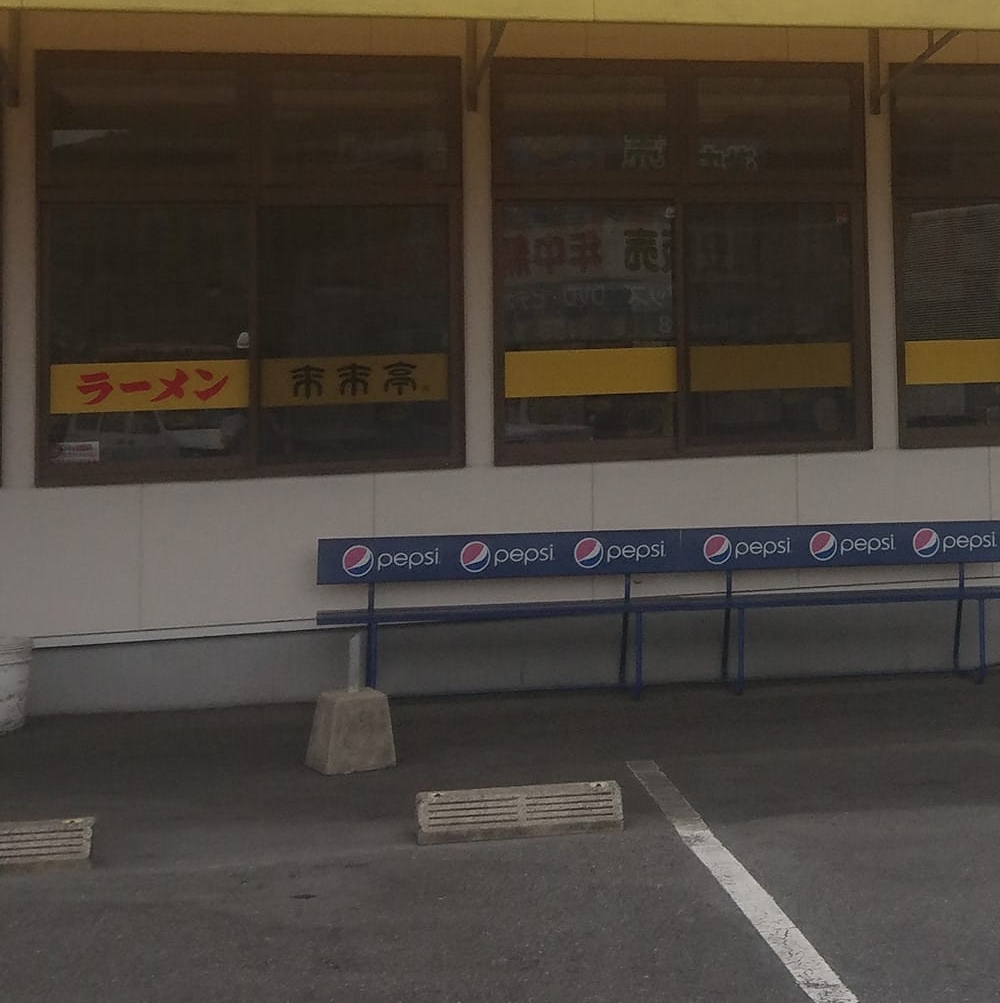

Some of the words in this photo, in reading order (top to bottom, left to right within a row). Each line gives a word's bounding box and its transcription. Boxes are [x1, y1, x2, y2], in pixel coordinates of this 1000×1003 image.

[76, 368, 229, 406] ラーメン
[607, 540, 666, 564] pepsi
[735, 537, 791, 559] pepsi
[840, 533, 896, 555] pepsi
[943, 531, 997, 553] pepsi
[377, 547, 440, 571] pepsi
[494, 544, 555, 568] pepsi
